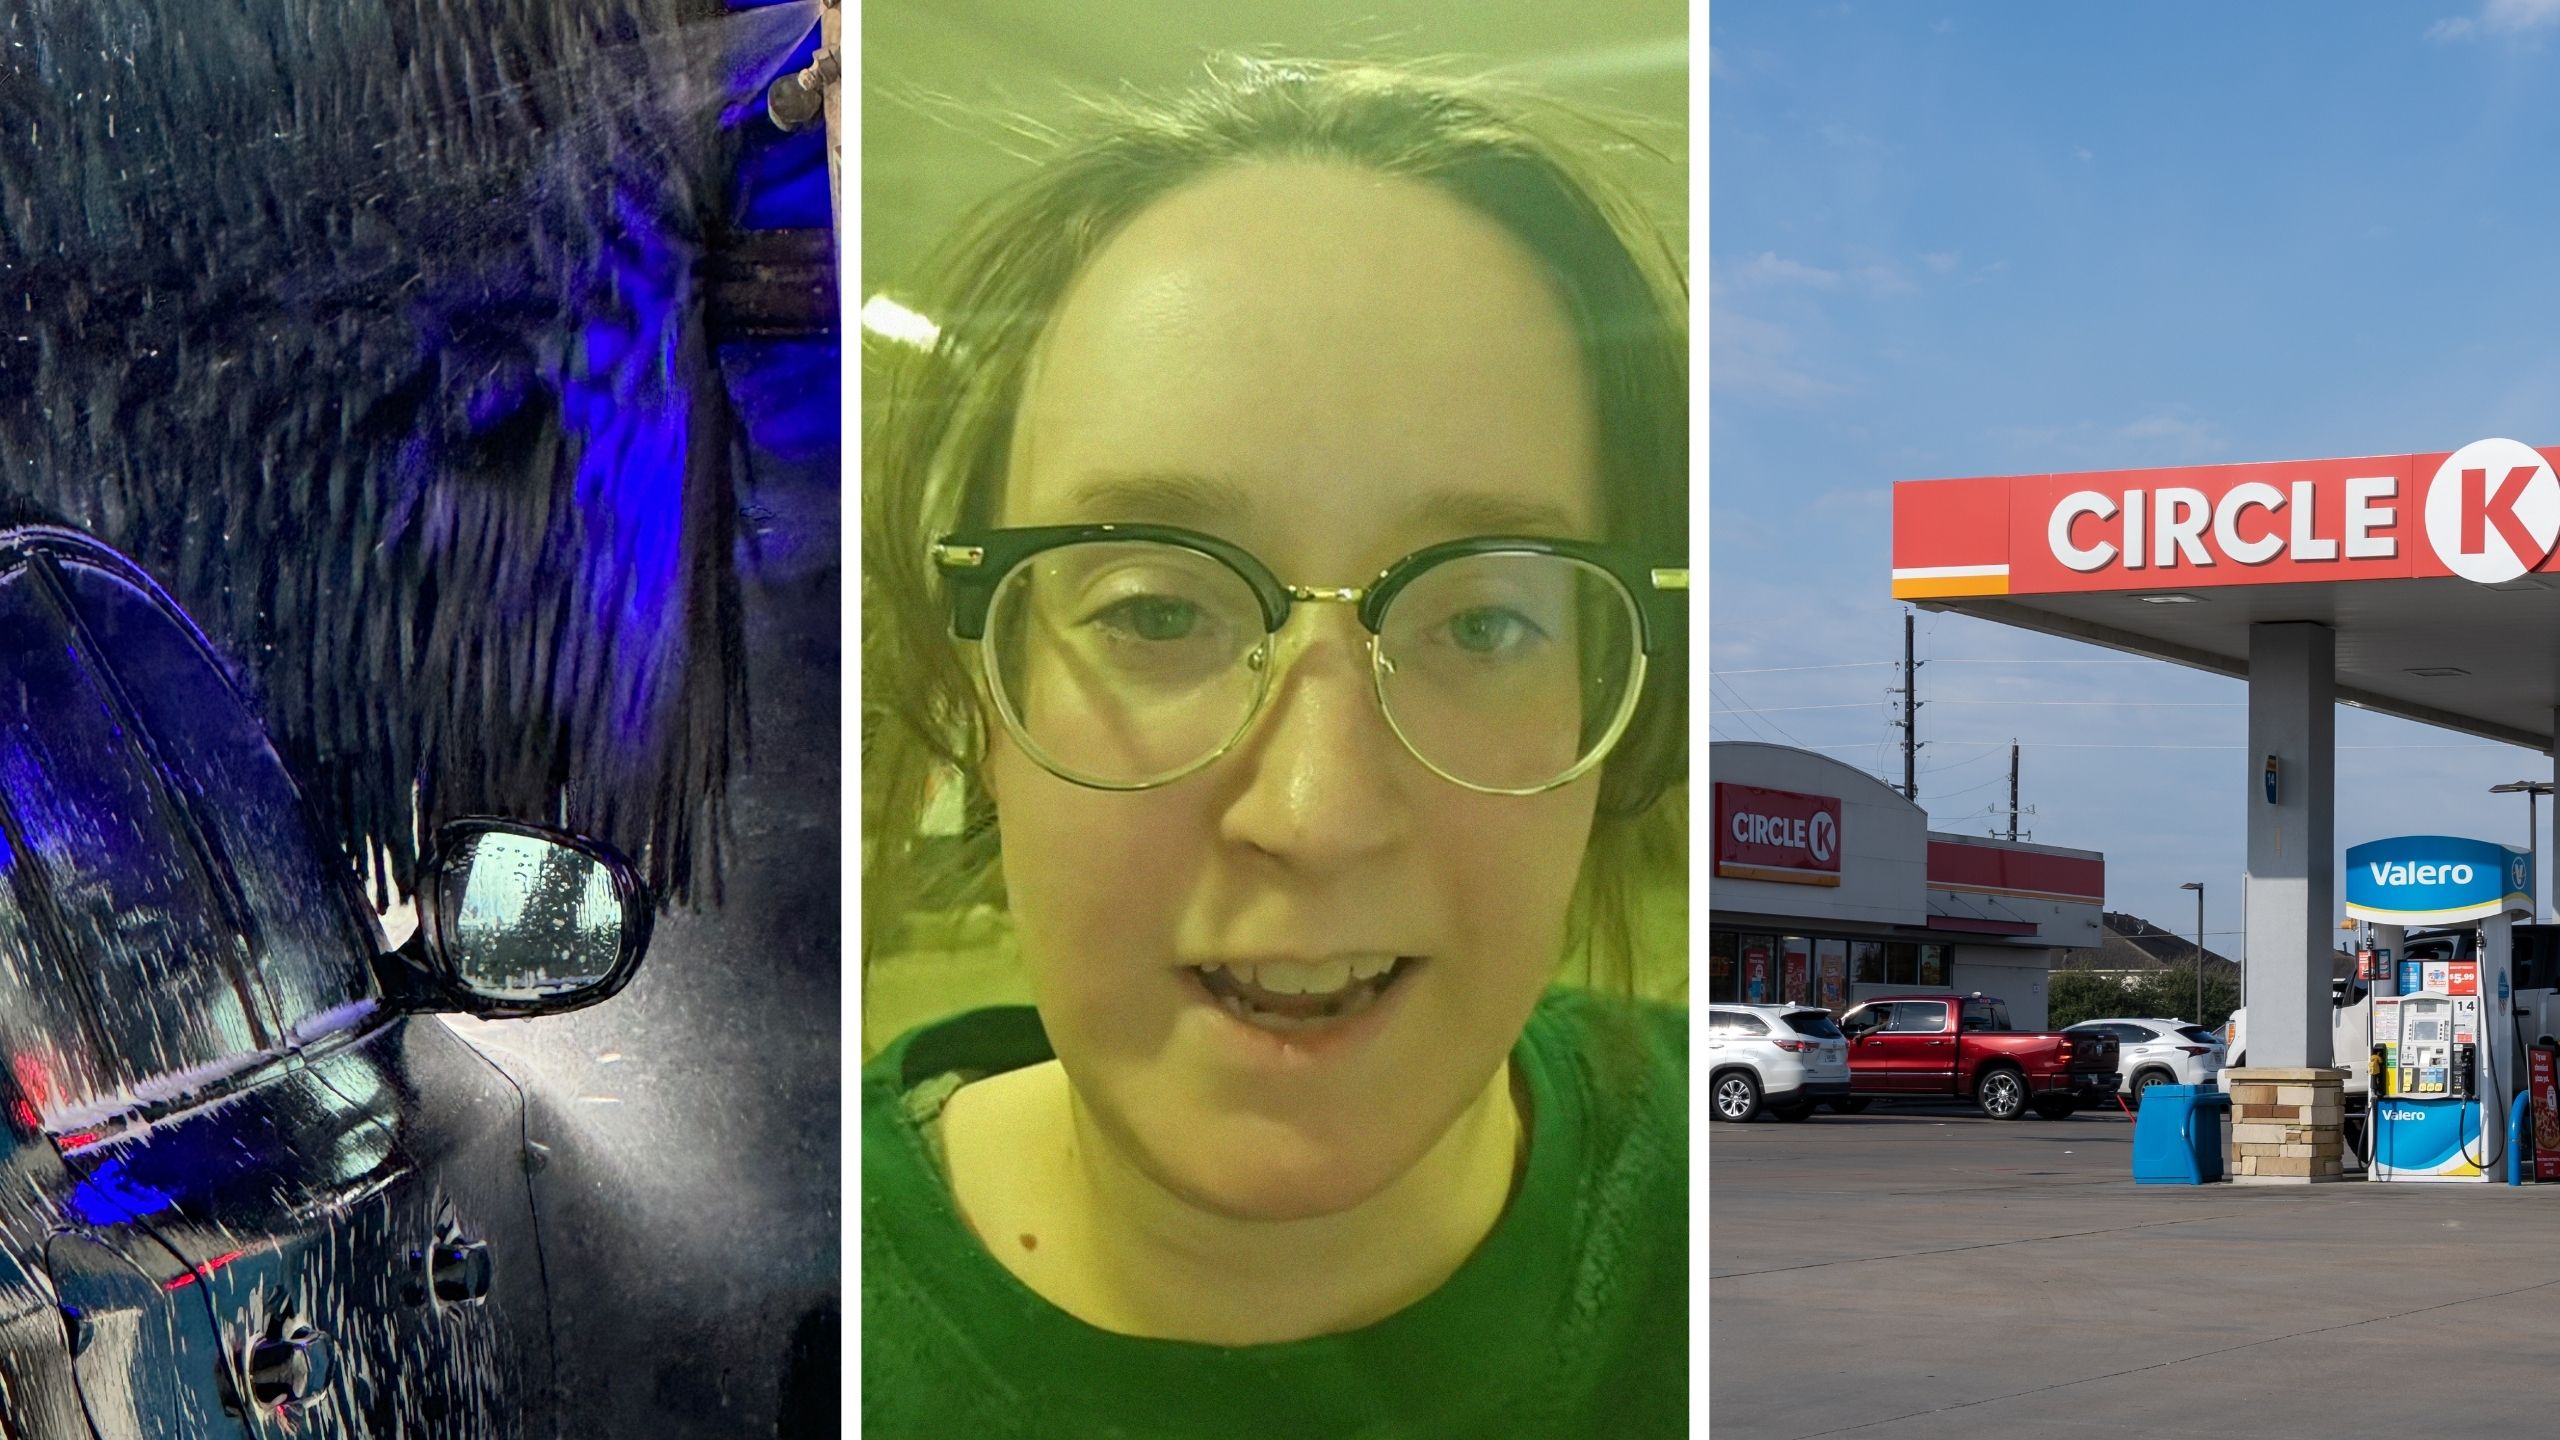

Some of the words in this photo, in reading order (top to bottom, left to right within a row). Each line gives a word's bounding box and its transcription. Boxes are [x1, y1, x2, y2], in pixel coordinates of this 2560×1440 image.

[2047, 475, 2398, 572] CIRCLE
[2459, 464, 2551, 574] K
[1732, 811, 1806, 849] CIRCLE
[1816, 819, 1836, 859] K
[2369, 860, 2474, 886] Valero
[2382, 1109, 2426, 1121] Valero
